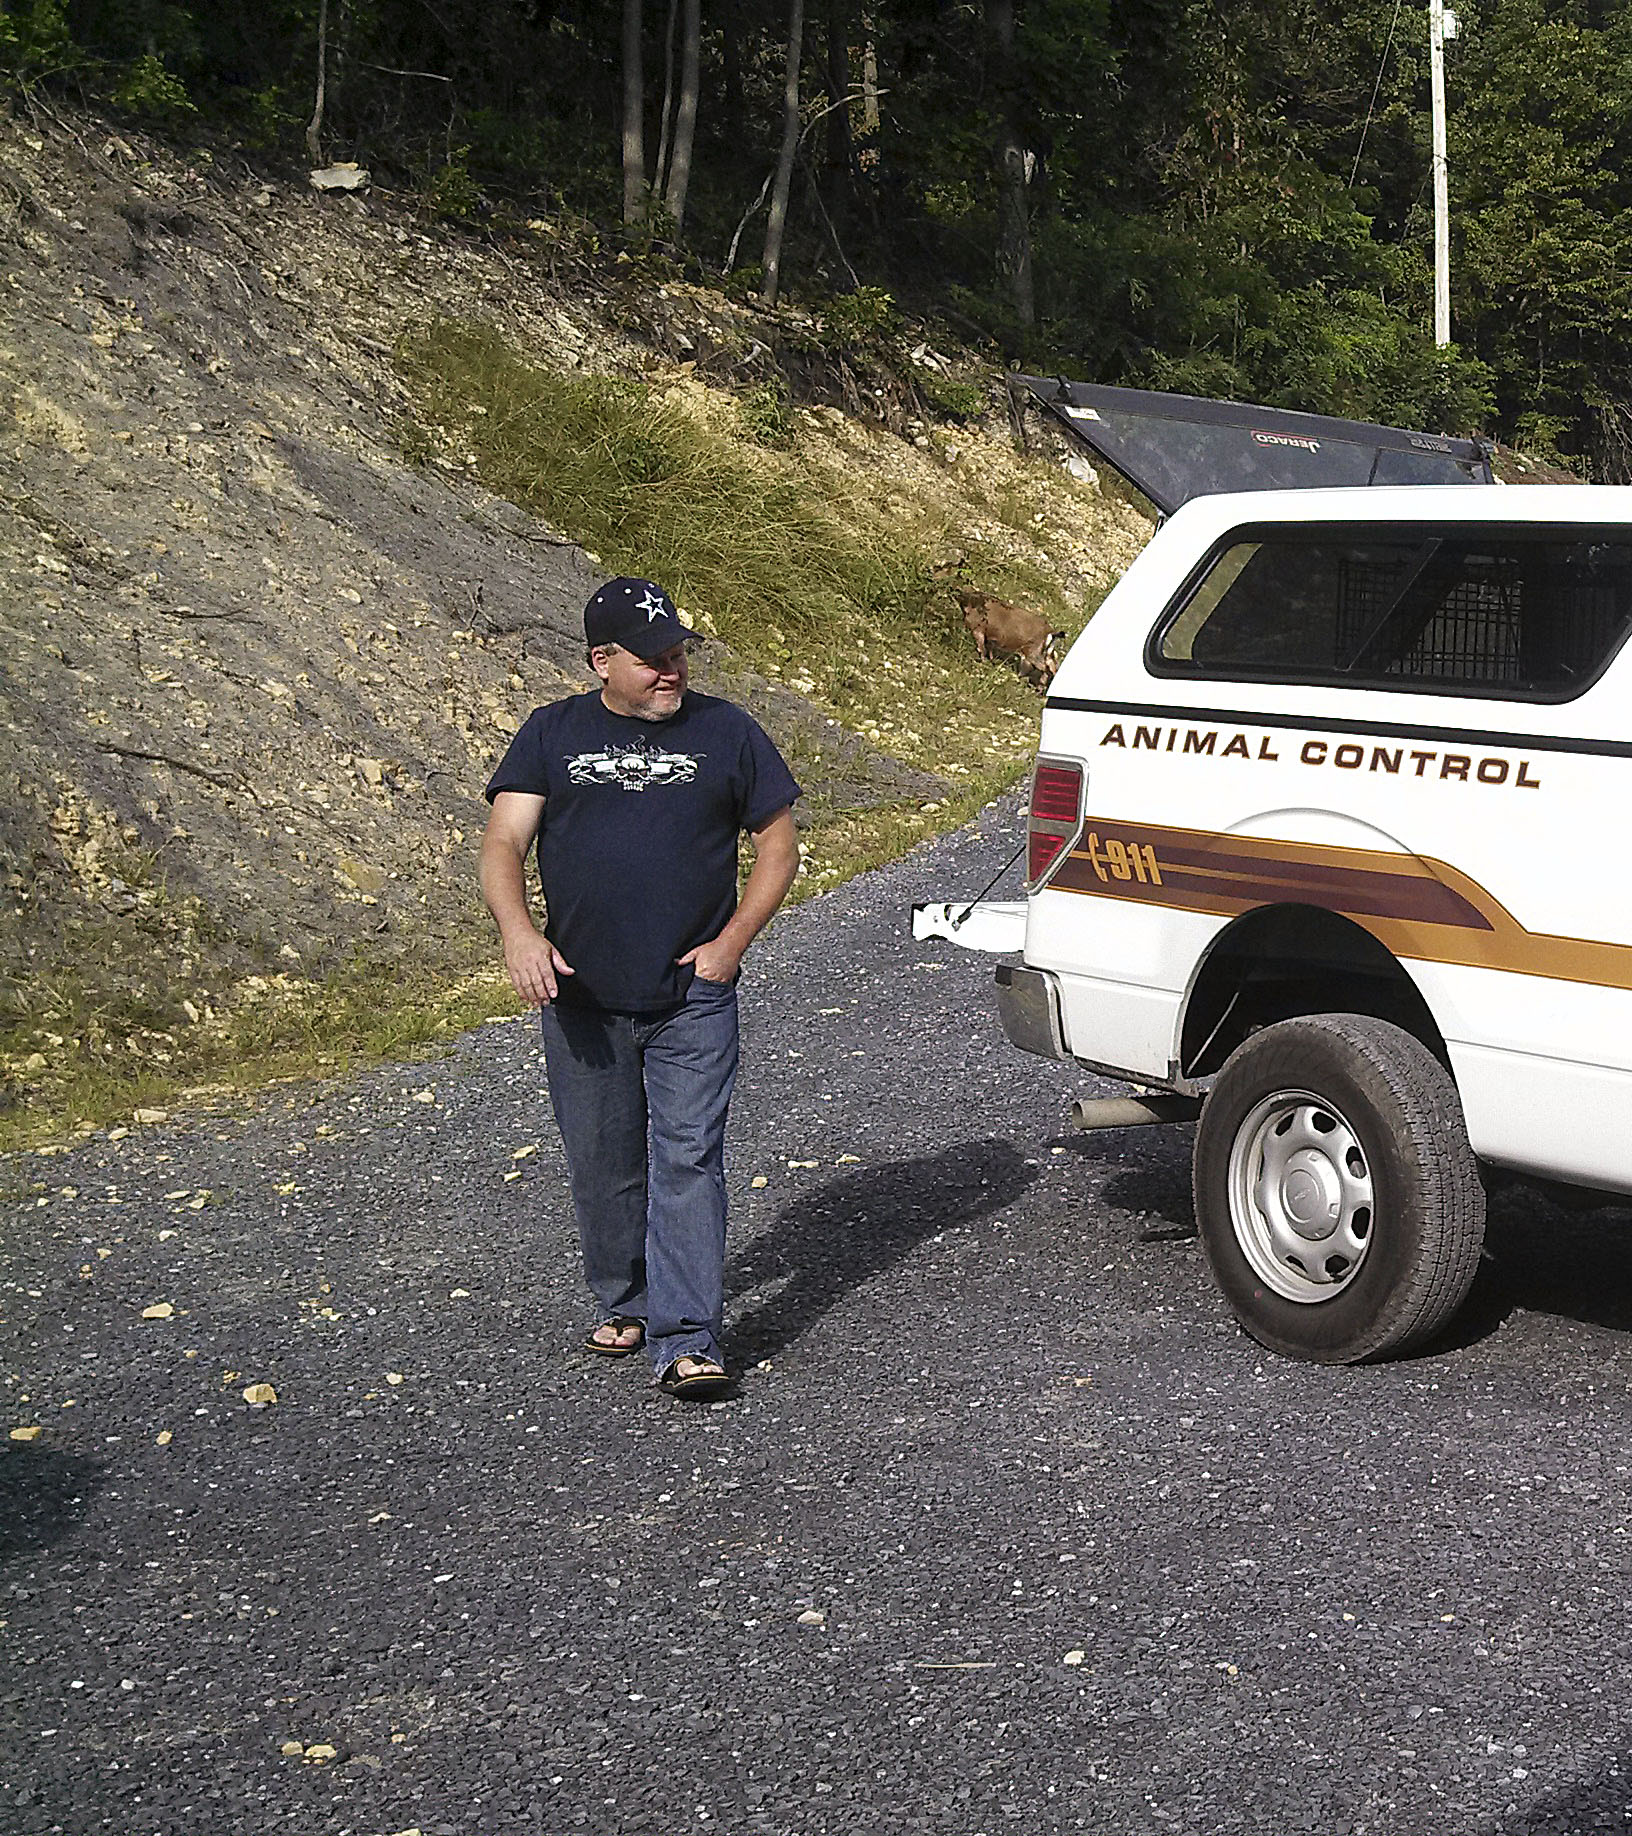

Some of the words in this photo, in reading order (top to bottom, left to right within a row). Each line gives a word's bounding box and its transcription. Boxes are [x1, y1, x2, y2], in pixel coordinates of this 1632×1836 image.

[1256, 433, 1321, 454] JERACO
[1099, 723, 1279, 762] ANIMAL
[1299, 740, 1541, 790] CONTROL
[1105, 839, 1163, 886] 911
